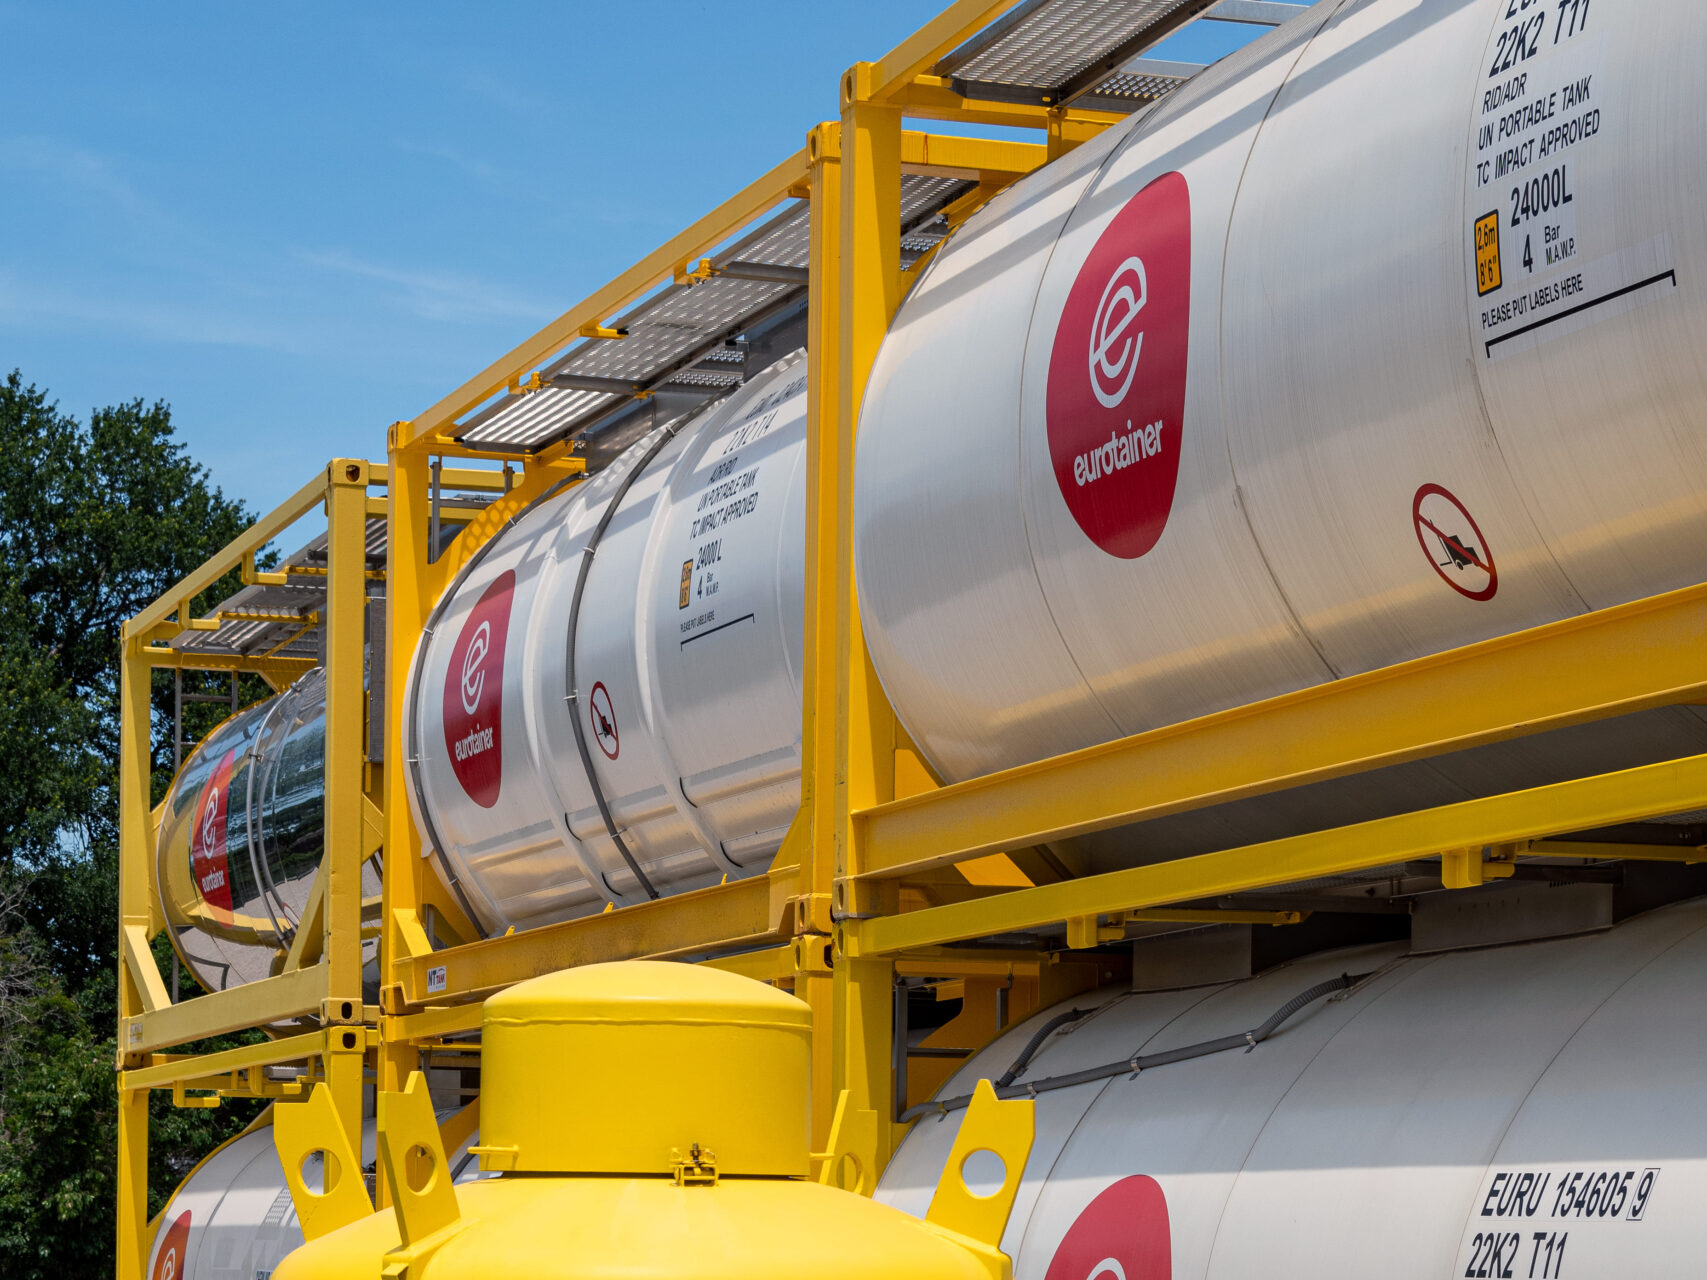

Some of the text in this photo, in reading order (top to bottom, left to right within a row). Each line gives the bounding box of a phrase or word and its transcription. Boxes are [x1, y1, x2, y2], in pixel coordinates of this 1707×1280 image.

[1489, 0, 1590, 78] 22K2 T11
[1478, 74, 1592, 151] UN PORTABLE TANK
[1482, 72, 1527, 115] RID/ADR
[1476, 108, 1600, 188] TC IMPACT APPROVED
[1510, 164, 1573, 228] 24000L
[1522, 233, 1533, 274] 4
[1544, 224, 1561, 244] Bar
[1482, 273, 1584, 330] PLEASE PUT LABELS HERE
[1073, 419, 1163, 487] eurotainer
[455, 722, 494, 762] eurotainer
[1480, 1171, 1551, 1217] EURU
[1551, 1170, 1635, 1218] 154605
[1464, 1231, 1568, 1280] 22K2 T11
